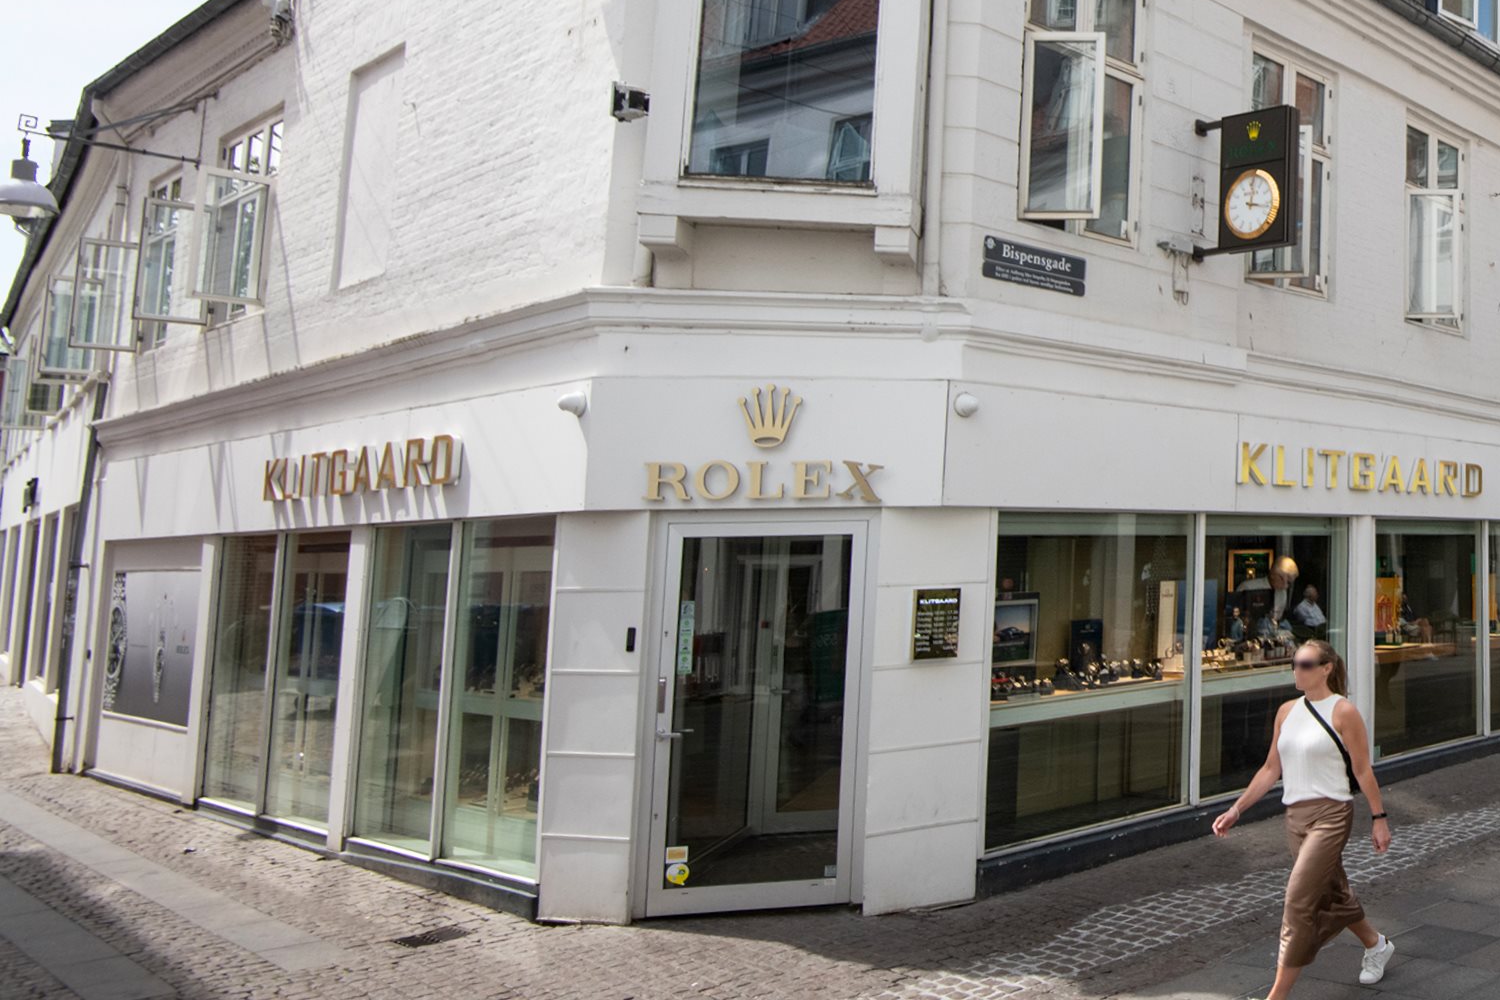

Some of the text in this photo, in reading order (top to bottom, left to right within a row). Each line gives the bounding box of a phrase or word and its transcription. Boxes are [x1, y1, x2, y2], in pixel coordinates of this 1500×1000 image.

[1002, 243, 1072, 273] Bispensgade
[263, 434, 460, 501] KLITGAARD
[642, 459, 885, 503] ROLEX
[1239, 441, 1484, 497] KLITGAARD
